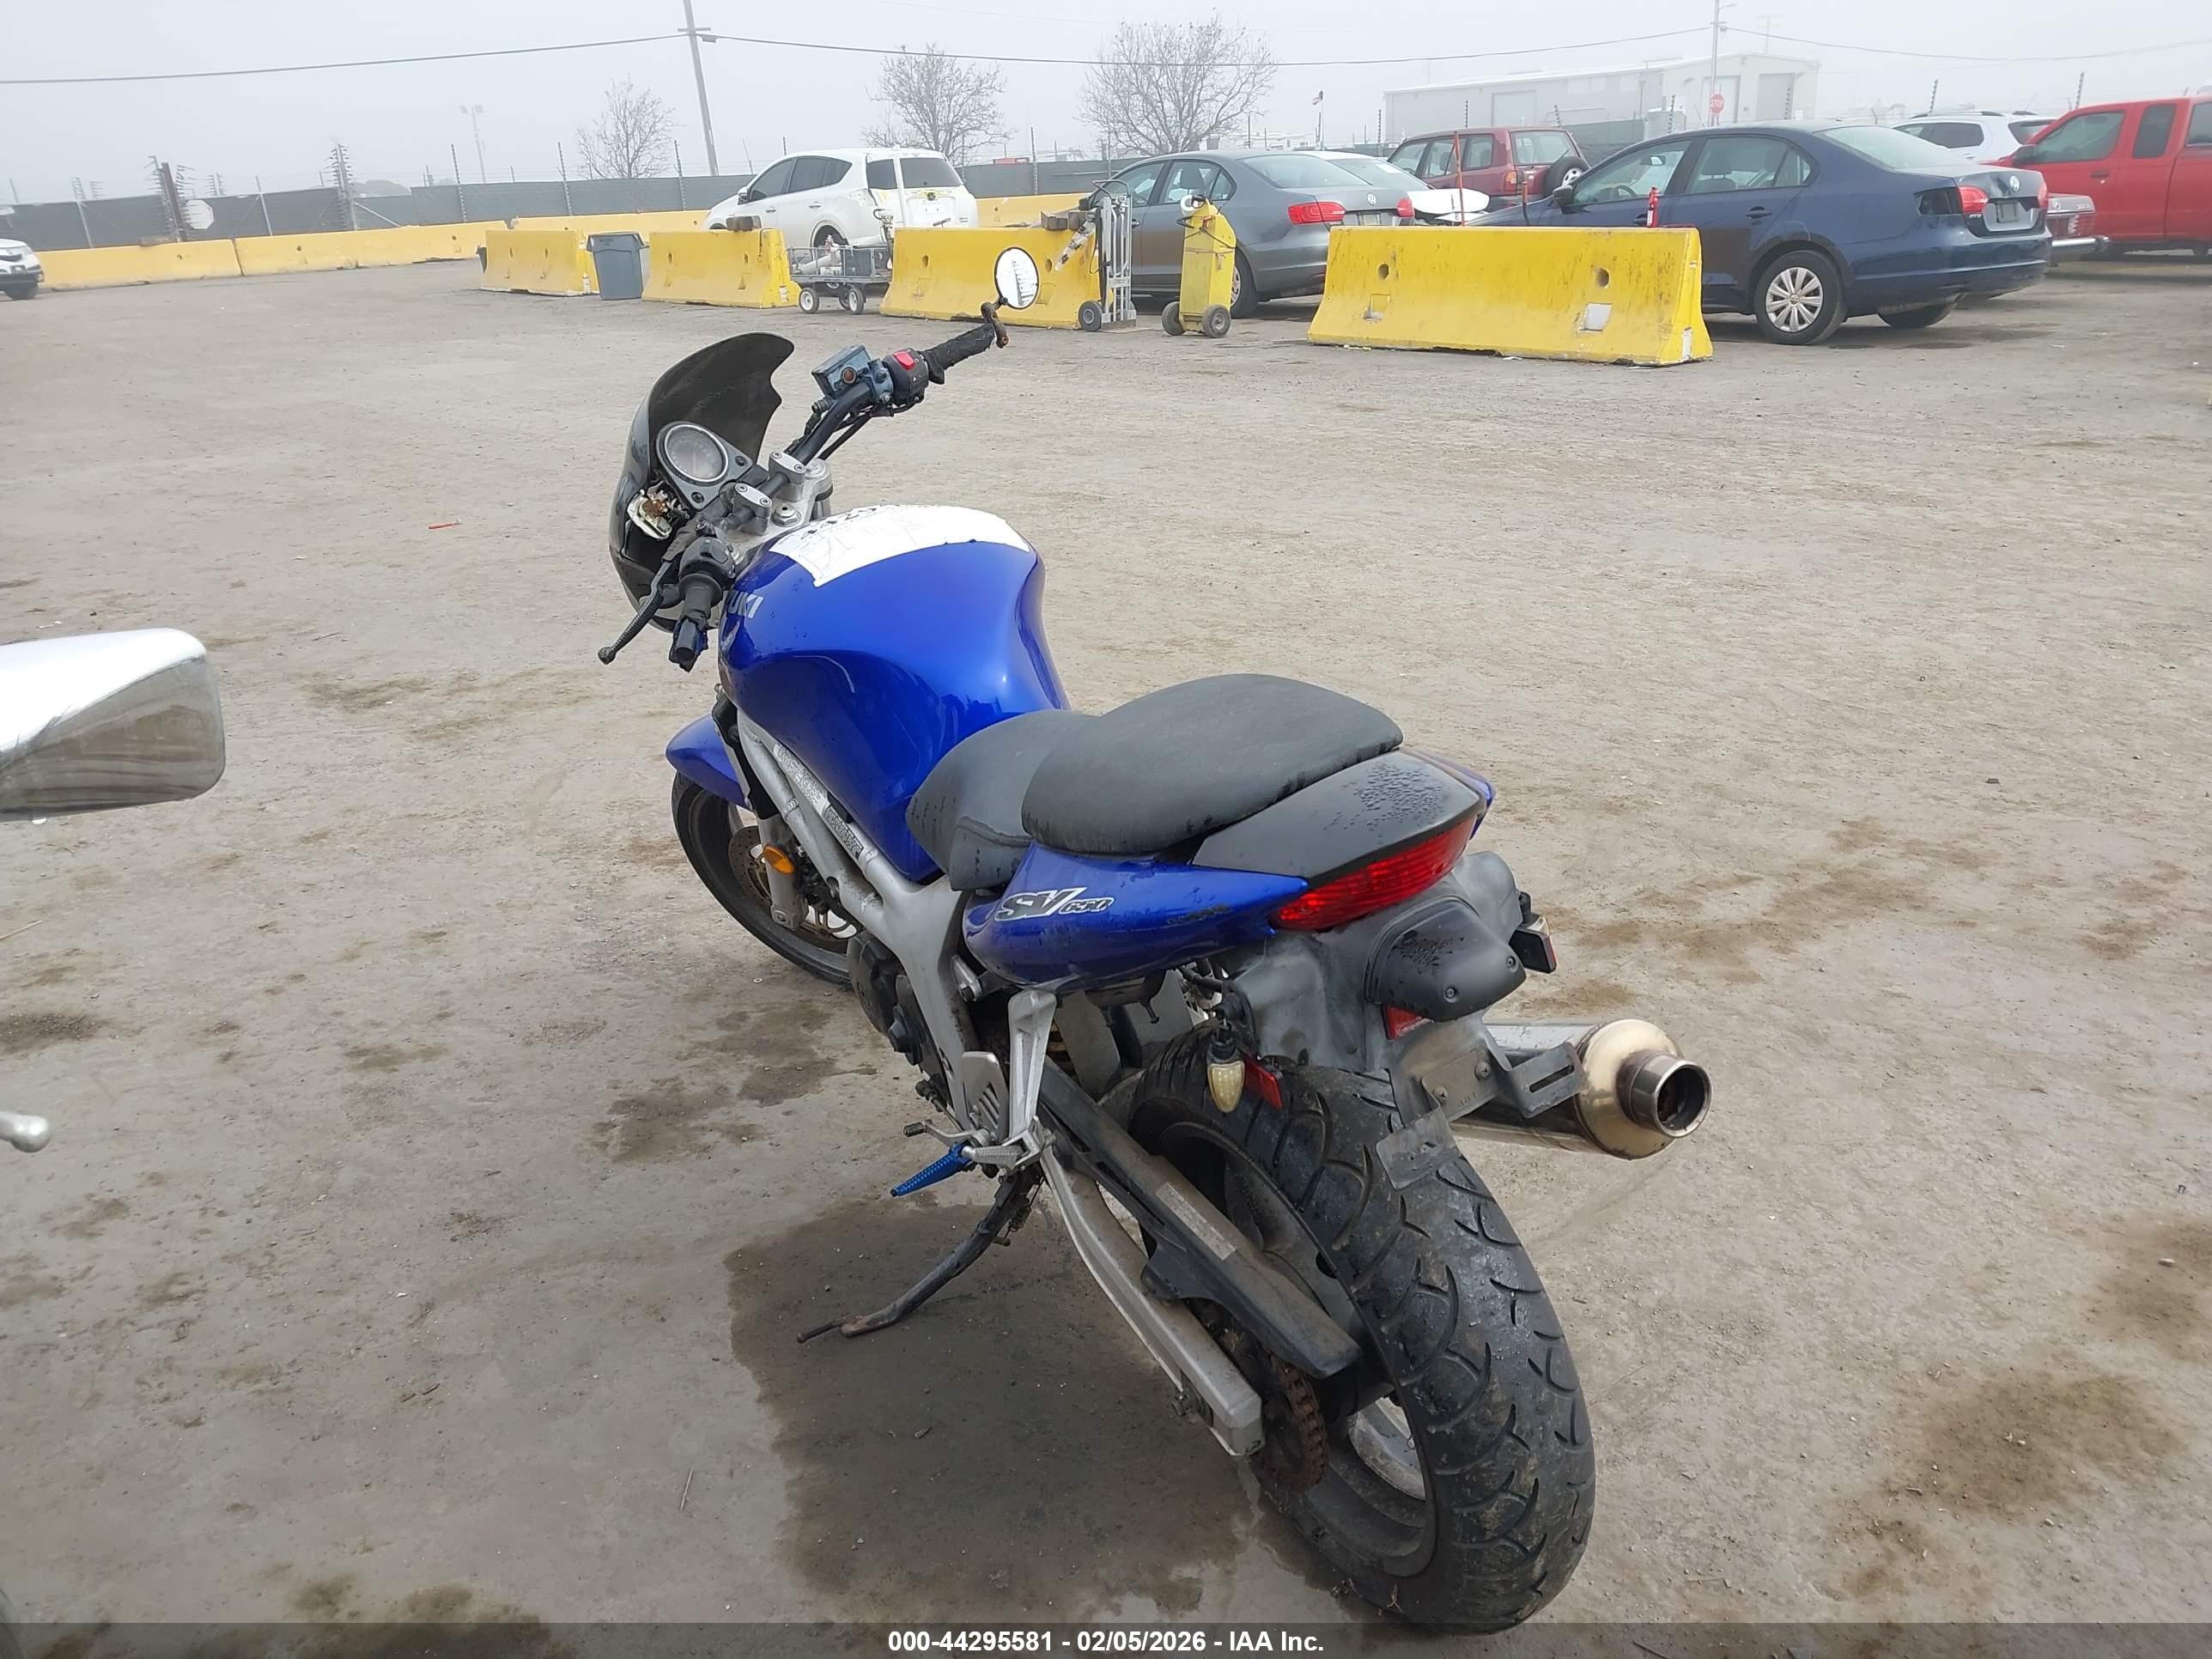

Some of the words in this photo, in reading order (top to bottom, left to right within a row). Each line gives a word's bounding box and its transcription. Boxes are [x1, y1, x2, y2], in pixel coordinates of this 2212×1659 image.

[726, 590, 764, 619] UKI
[994, 887, 1087, 921] SV
[1059, 897, 1115, 915] 650
